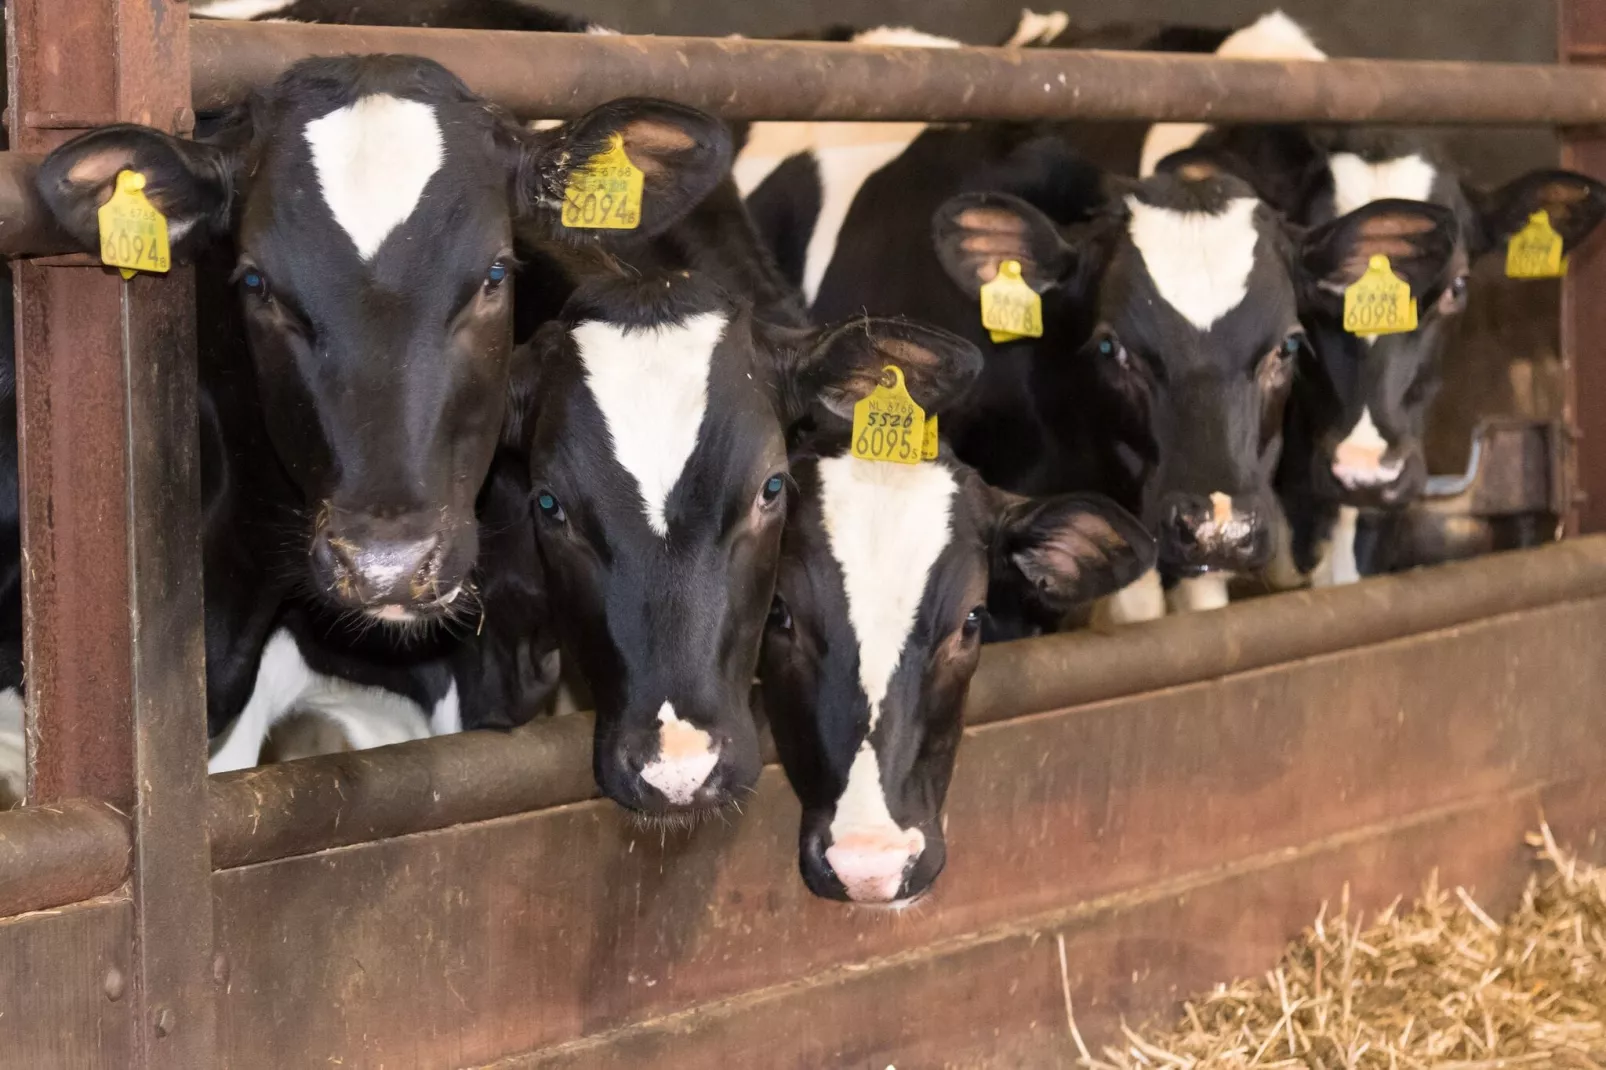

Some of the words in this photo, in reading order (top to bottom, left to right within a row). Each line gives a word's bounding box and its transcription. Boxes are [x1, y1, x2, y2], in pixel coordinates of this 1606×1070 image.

[566, 193, 628, 225] 6094
[105, 231, 159, 268] 6094
[1347, 302, 1397, 328] 6098
[867, 411, 914, 429] 5526
[868, 400, 882, 412] NL
[856, 427, 911, 459] 6095
